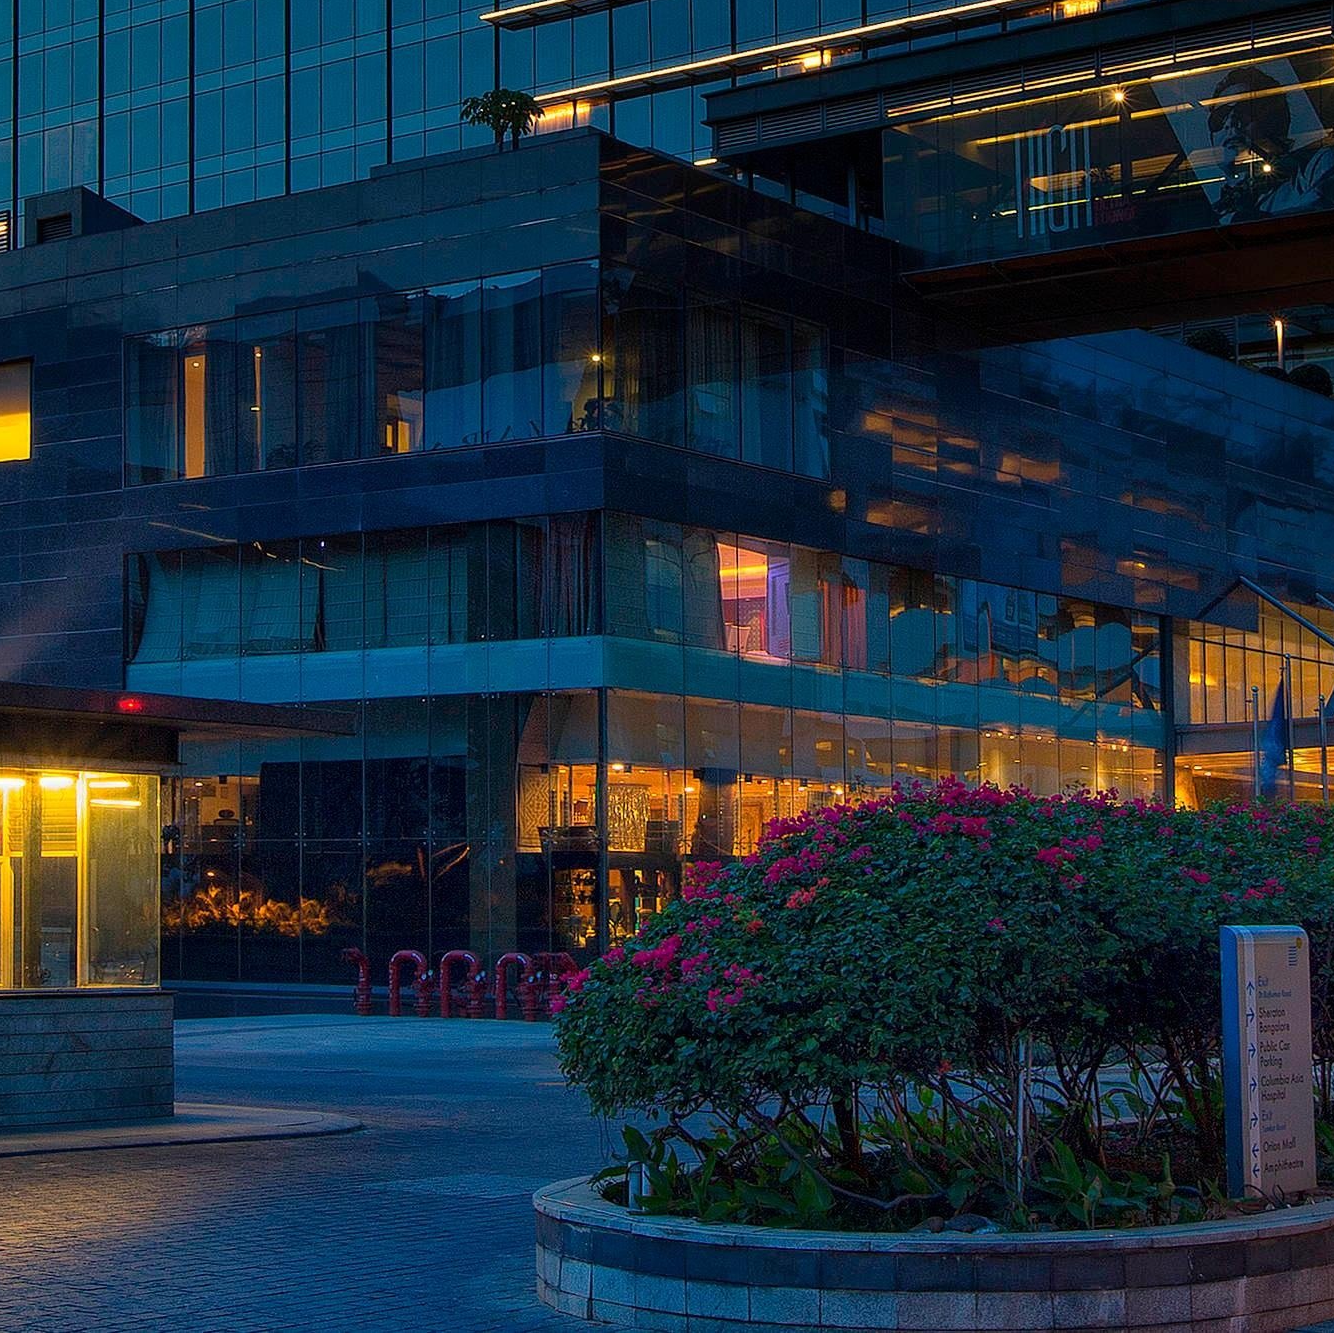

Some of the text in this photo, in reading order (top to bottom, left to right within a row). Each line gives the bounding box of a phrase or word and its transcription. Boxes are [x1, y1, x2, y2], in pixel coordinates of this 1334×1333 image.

[1258, 1007, 1286, 1019] Sheraton
[1259, 1019, 1290, 1035] Bangalore
[1259, 1040, 1291, 1053] Public Car
[1260, 1054, 1283, 1069] Parking
[1261, 1072, 1304, 1087] Columbia Asia
[1261, 1087, 1286, 1104] Hospital
[1264, 1158, 1304, 1176] Amphitheatre
